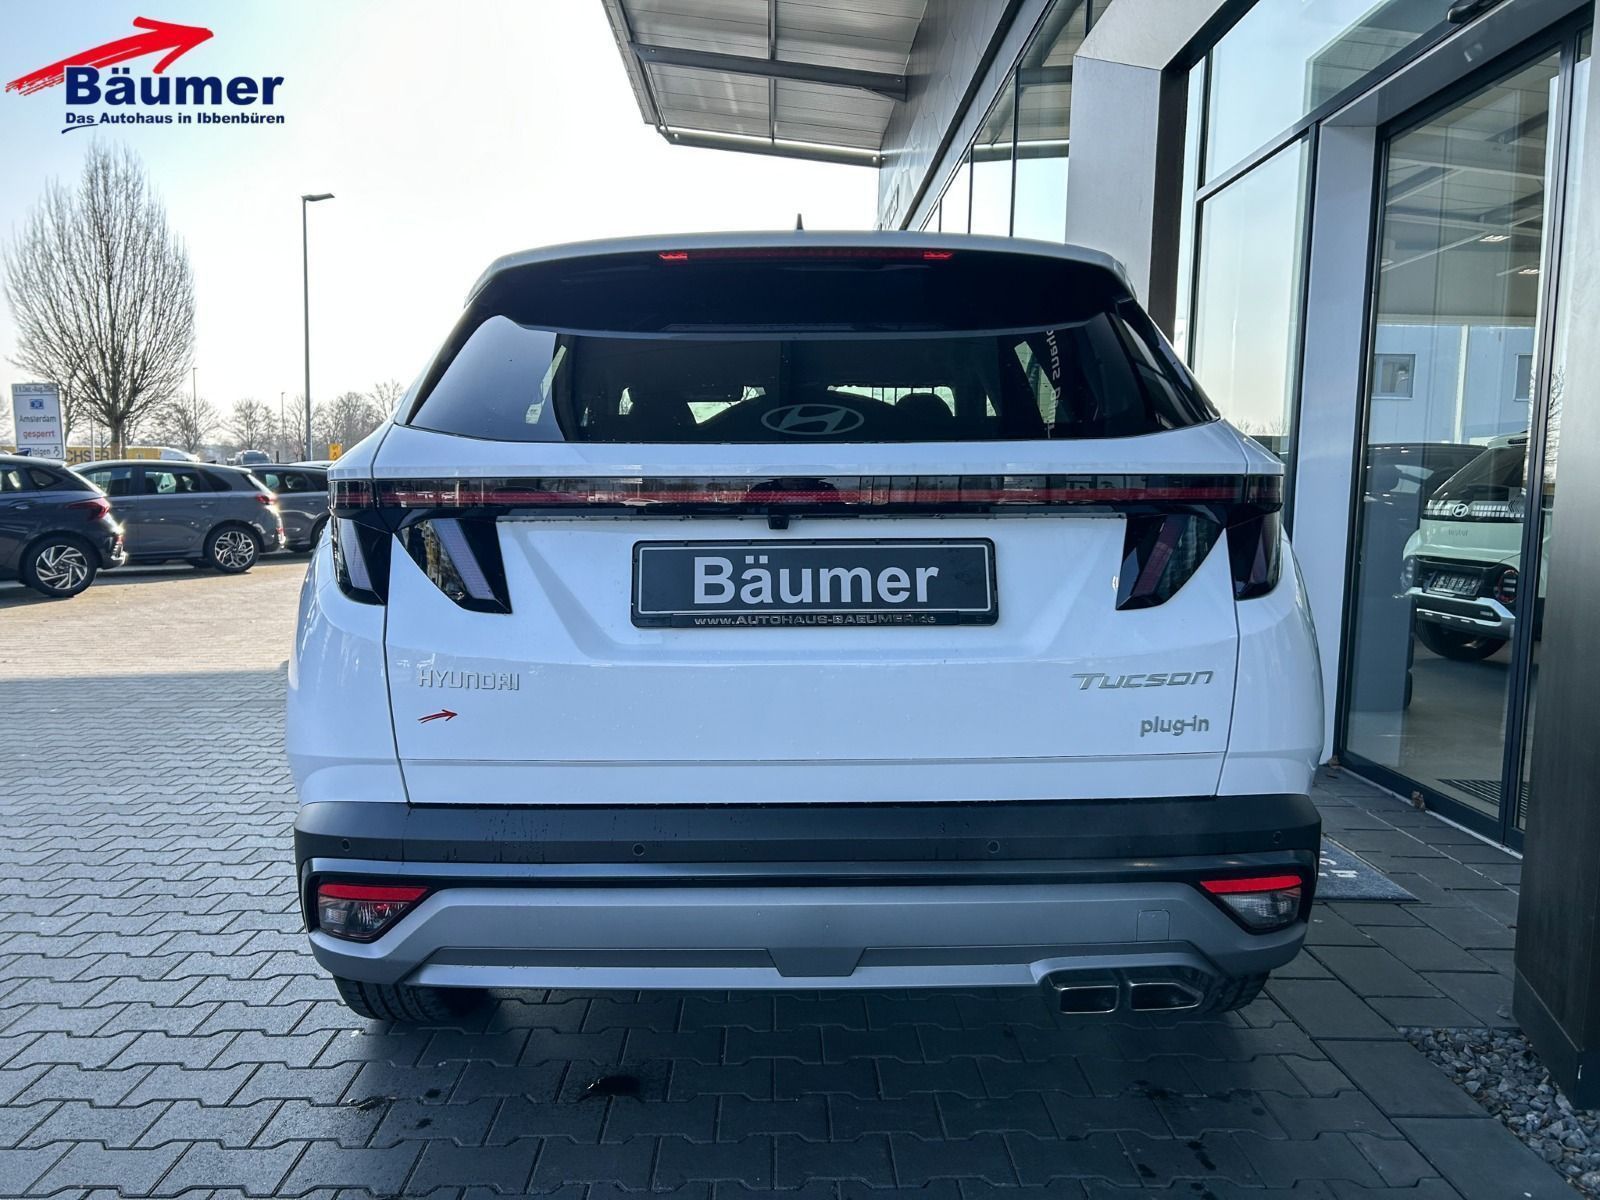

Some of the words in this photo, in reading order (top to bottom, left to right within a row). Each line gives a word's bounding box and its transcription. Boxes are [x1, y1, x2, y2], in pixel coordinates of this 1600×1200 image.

[19, 415, 57, 423] Amsterdam
[23, 430, 56, 439] gesperrt
[694, 555, 939, 605] Bäumer
[418, 669, 521, 691] HYUNDAI
[1139, 715, 1209, 738] plug-in
